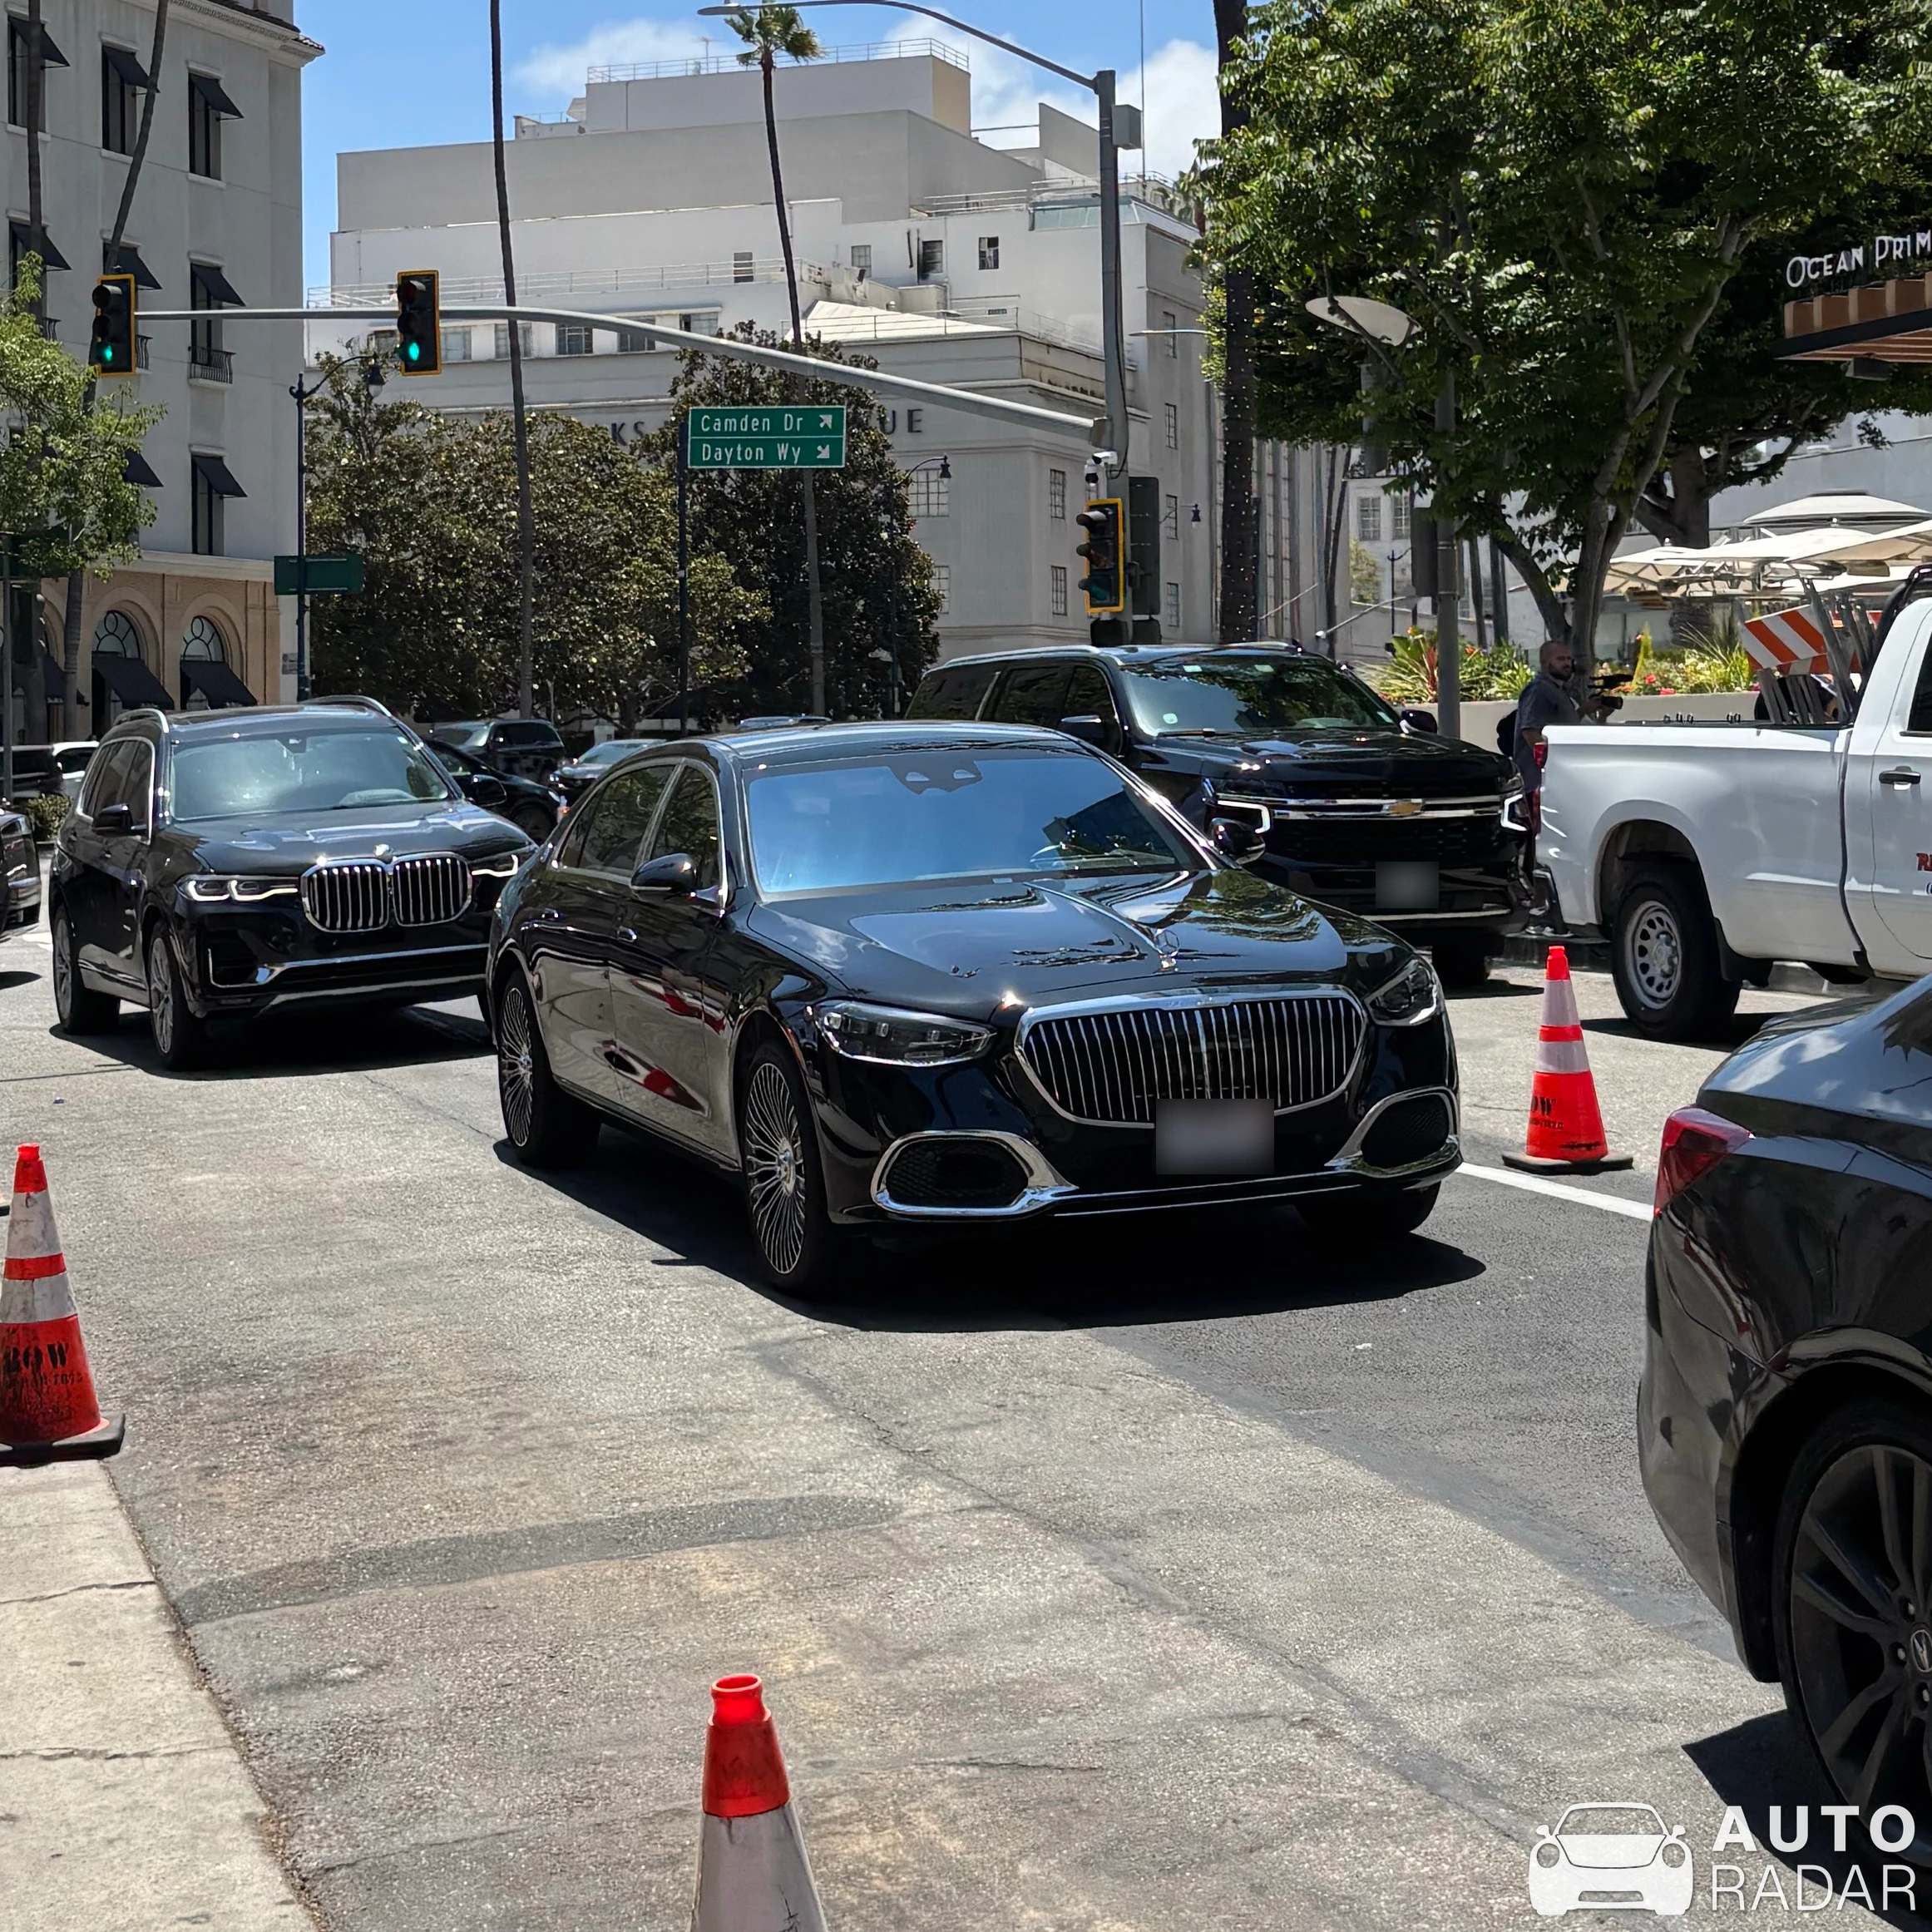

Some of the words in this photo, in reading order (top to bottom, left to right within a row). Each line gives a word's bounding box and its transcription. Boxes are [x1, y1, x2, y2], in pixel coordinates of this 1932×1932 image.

[1786, 245, 1864, 288] OCEAN
[1875, 229, 1932, 269] PRIM
[700, 414, 770, 432] Camden
[783, 413, 803, 432] Dr
[701, 442, 764, 465] Dayton
[776, 442, 801, 465] Wy
